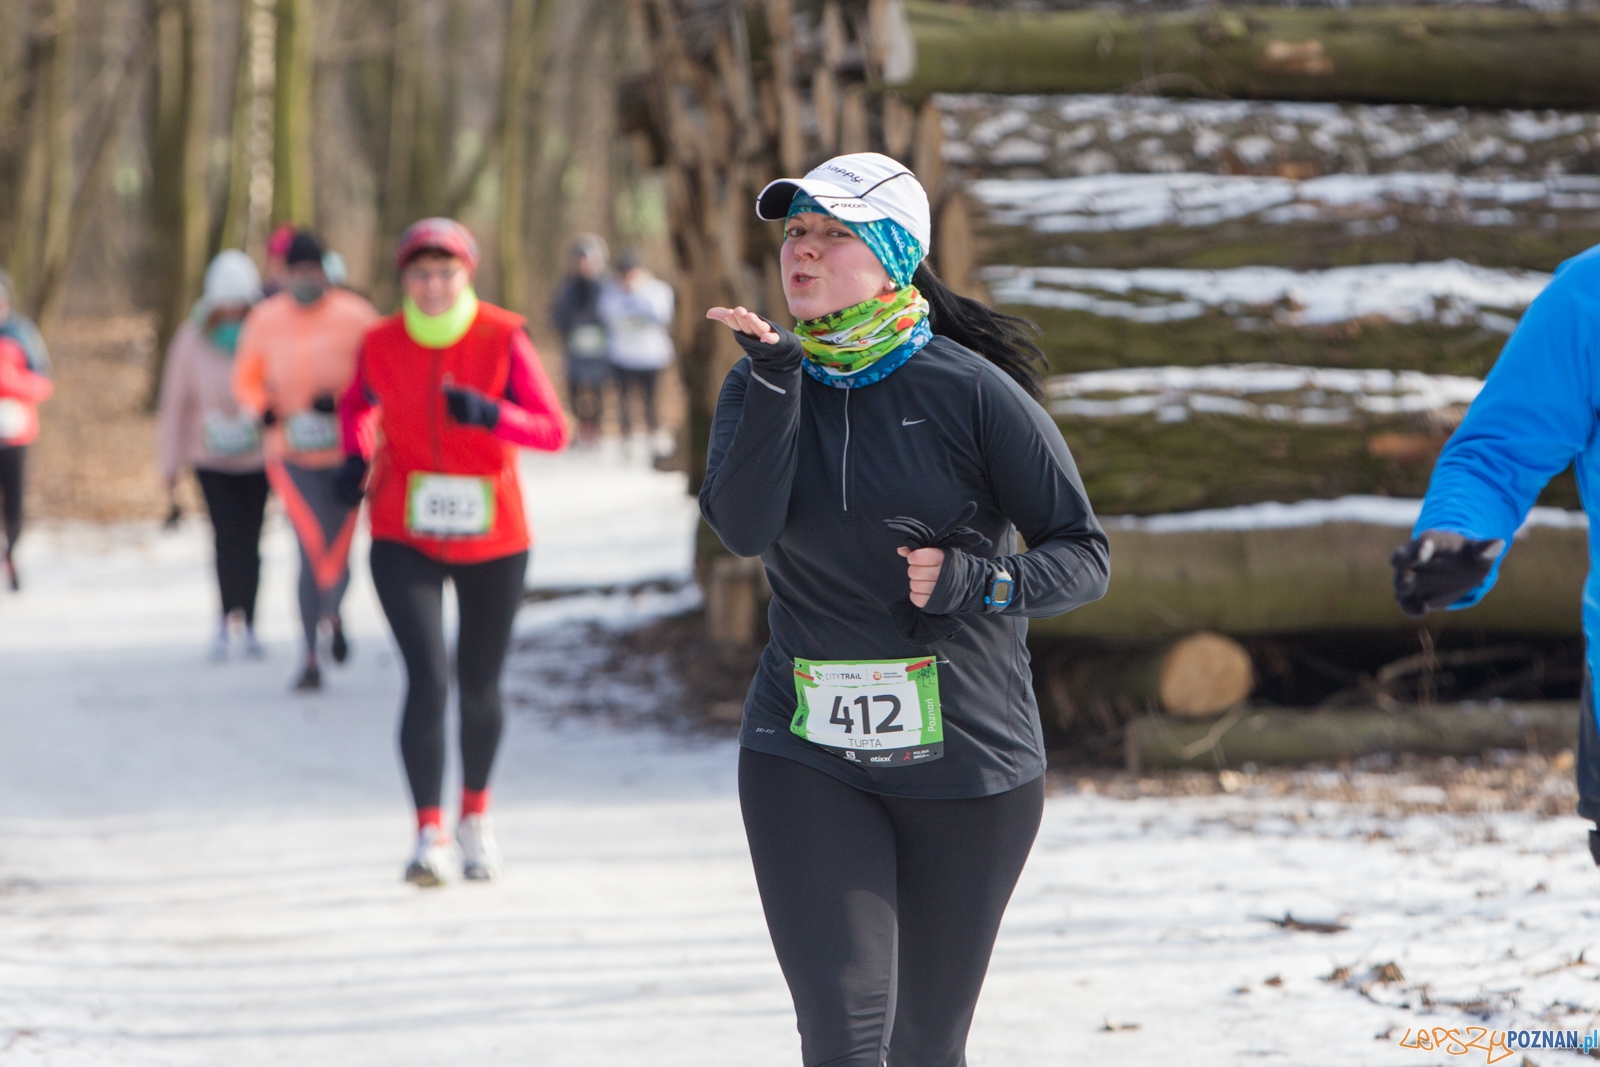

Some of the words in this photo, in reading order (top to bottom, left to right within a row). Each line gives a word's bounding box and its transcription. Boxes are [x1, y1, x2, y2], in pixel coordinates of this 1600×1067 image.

[829, 694, 904, 735] 412
[925, 698, 936, 732] Poznań
[848, 738, 882, 748] TUPTA
